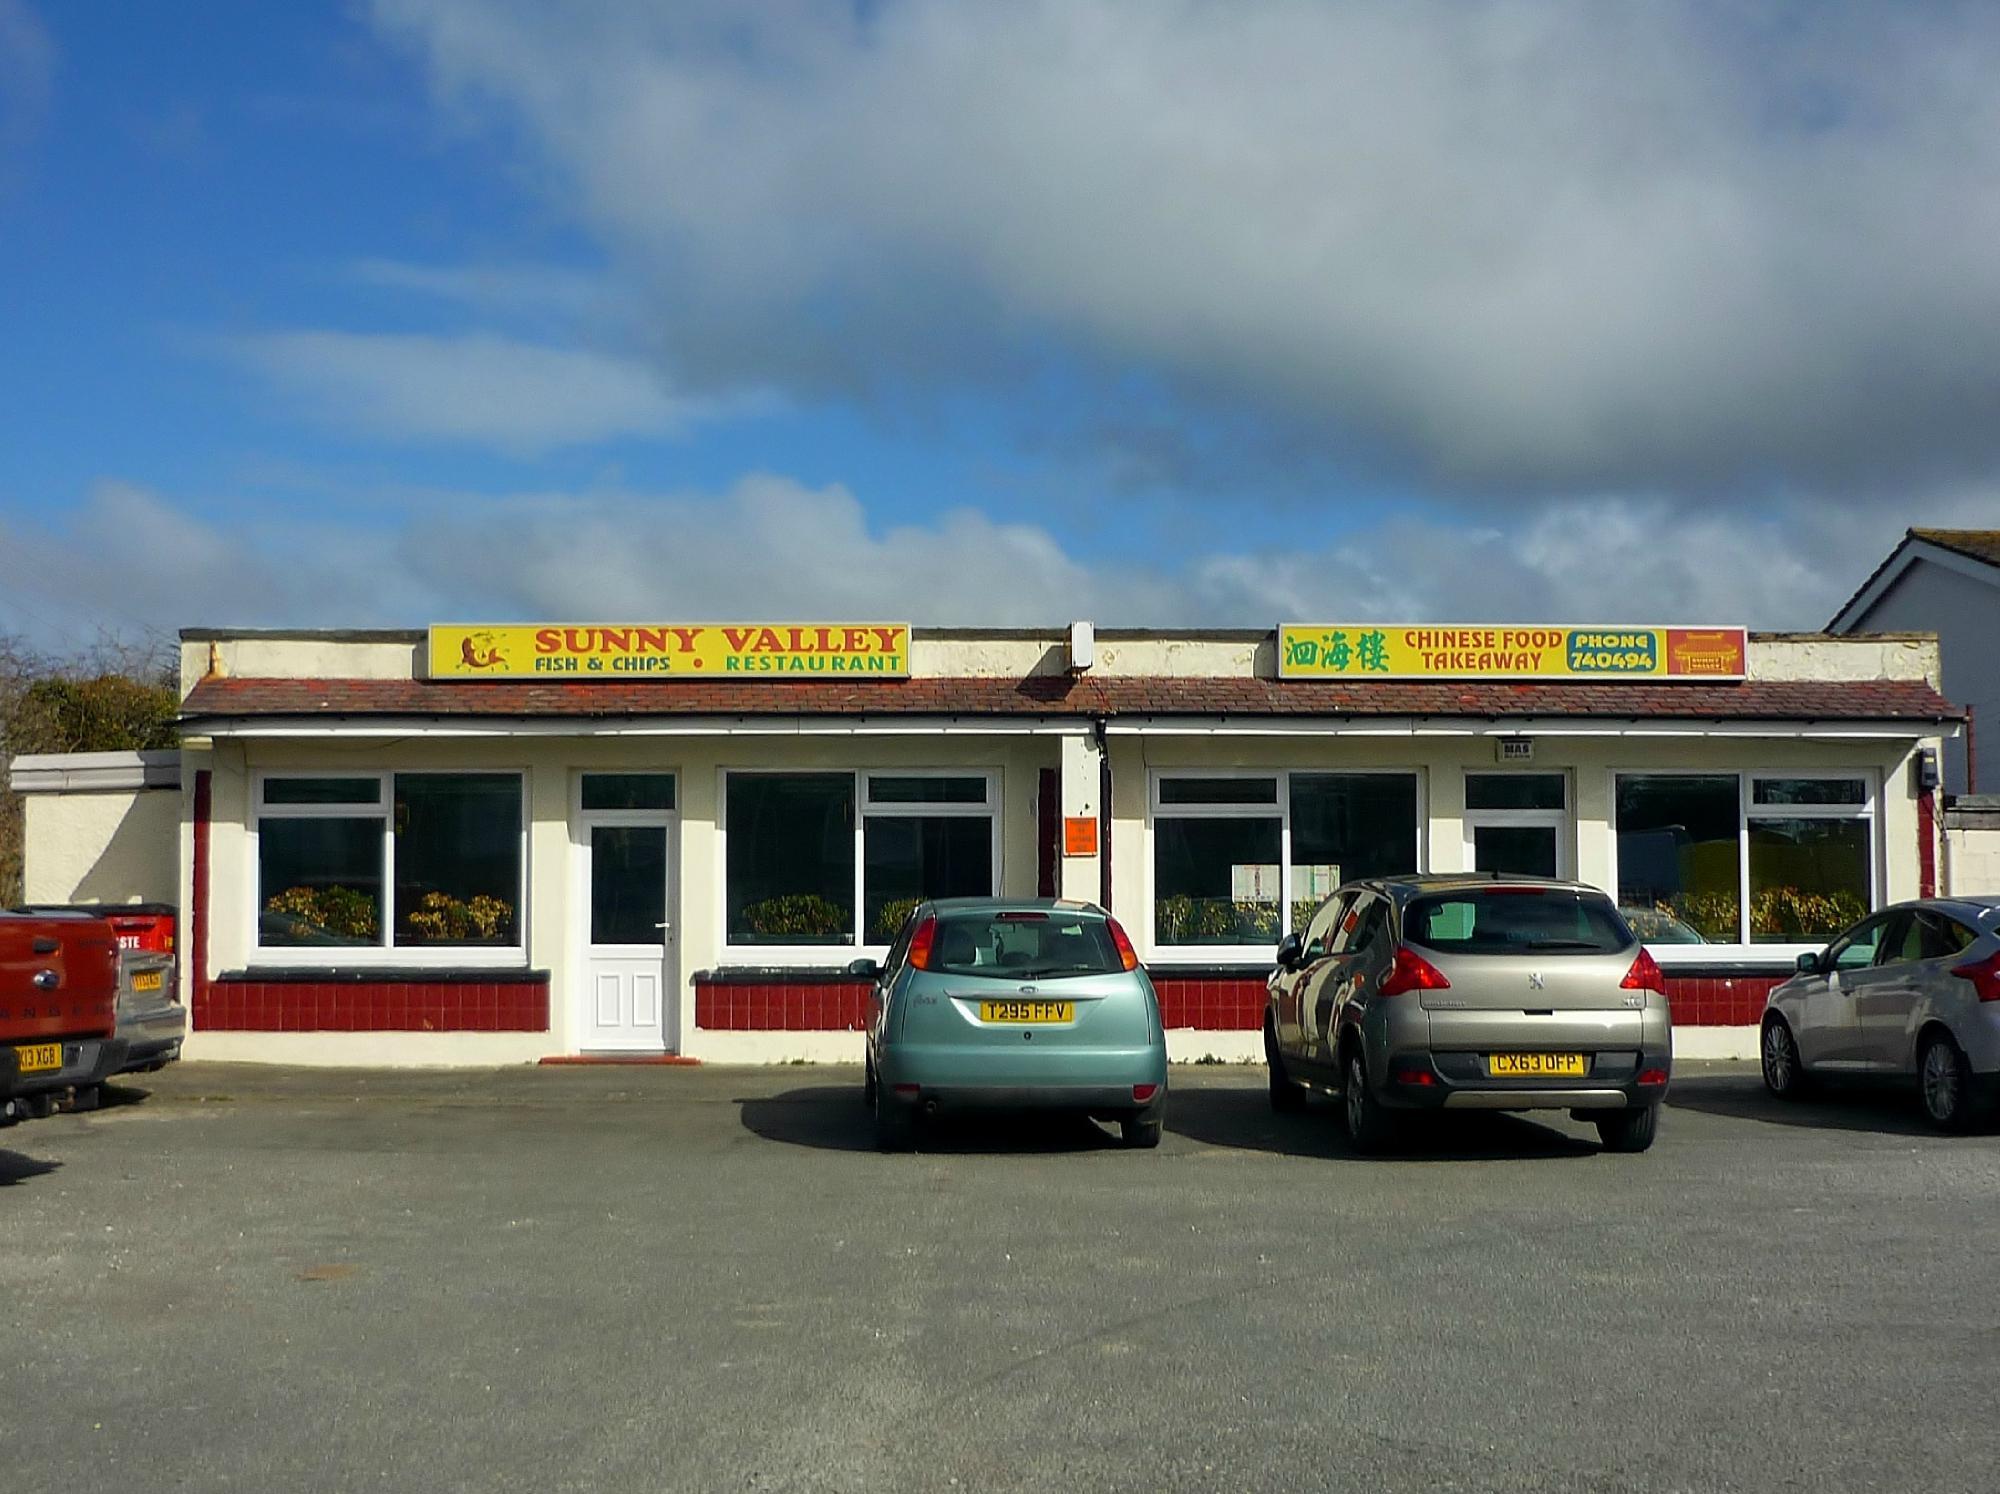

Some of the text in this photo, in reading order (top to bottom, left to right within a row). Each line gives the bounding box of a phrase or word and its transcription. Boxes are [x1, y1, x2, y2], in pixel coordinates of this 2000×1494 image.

[535, 628, 905, 653] SUNNY VALLEY
[1404, 631, 1562, 649] CHINESE FOOD
[1575, 634, 1648, 648] PHONE
[535, 657, 671, 671] FISH & CHIPS
[726, 656, 900, 671] RESTAURANT
[1421, 652, 1542, 671] TAKEAWAY
[1570, 652, 1653, 671] 740494
[988, 1003, 1065, 1019] T295 FFV
[1497, 1054, 1541, 1070] CX63
